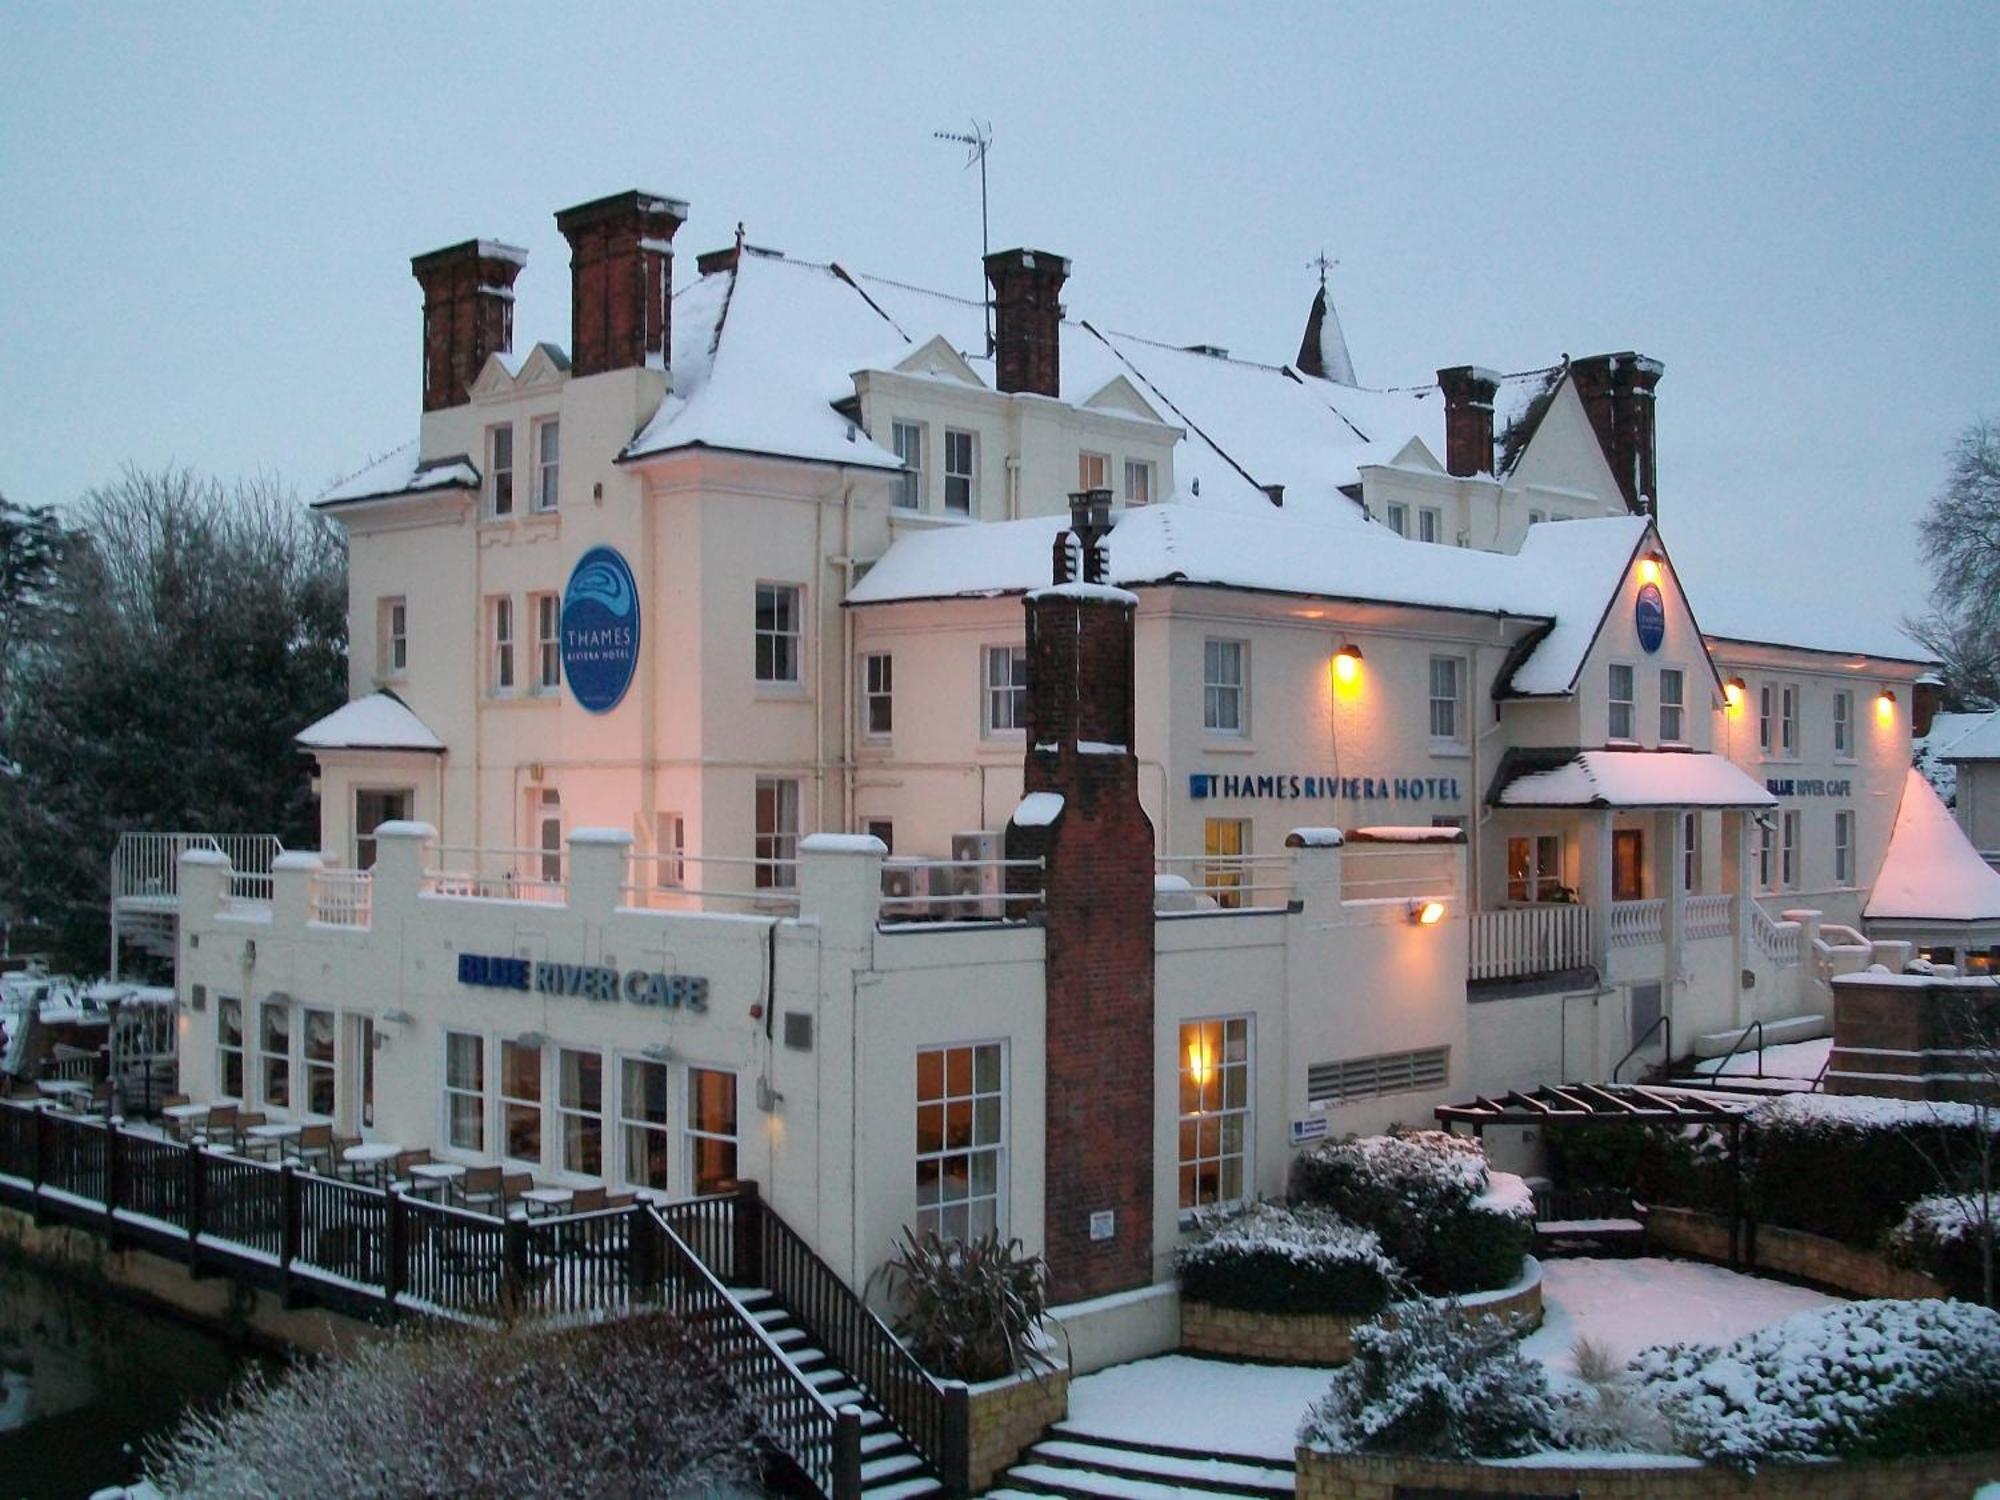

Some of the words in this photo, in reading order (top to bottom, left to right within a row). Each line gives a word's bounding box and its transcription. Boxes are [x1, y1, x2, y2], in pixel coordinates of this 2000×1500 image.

[568, 627, 630, 648] THAMES
[1209, 774, 1300, 799] THAMES
[1304, 776, 1390, 799] RIVIERA
[1394, 778, 1461, 800] HOTEL
[1766, 779, 1794, 796] BLUE
[458, 953, 531, 991] BLUE
[535, 961, 619, 1002] RIVER
[624, 970, 708, 1013] CAFE
